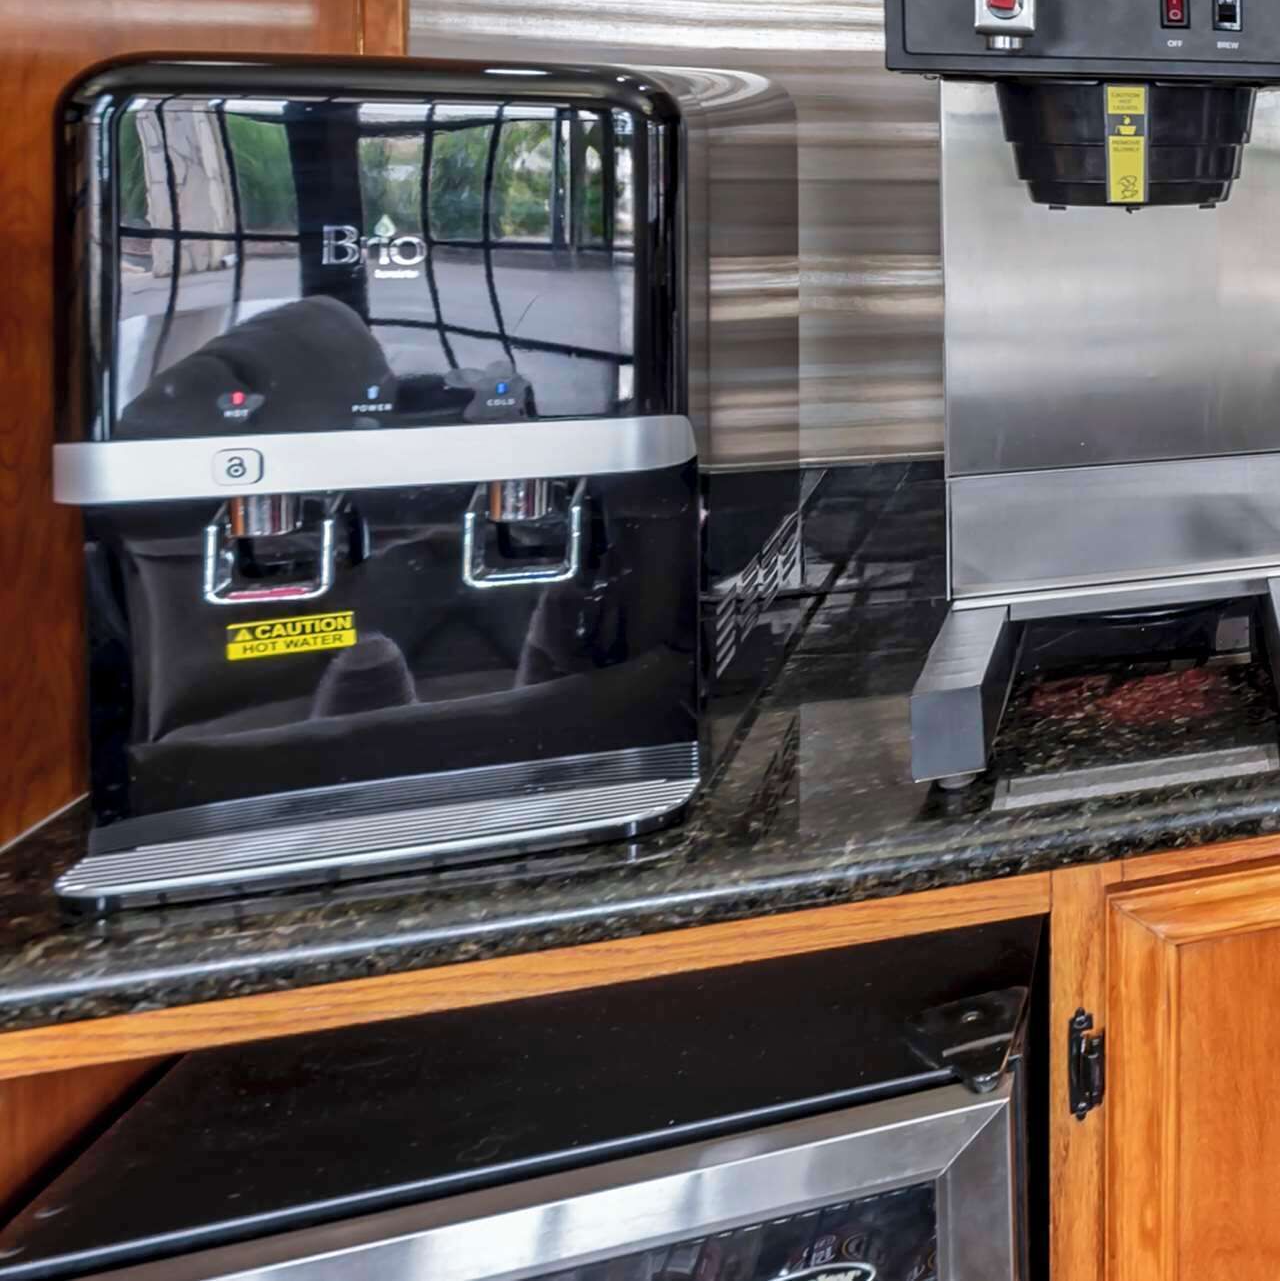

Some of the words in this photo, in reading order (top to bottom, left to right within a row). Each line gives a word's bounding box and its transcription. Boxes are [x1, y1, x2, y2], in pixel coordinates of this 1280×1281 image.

[1167, 39, 1184, 48] OFF
[1217, 40, 1239, 50] BREW
[322, 214, 428, 266] Brio
[352, 402, 393, 413] POWER
[486, 397, 517, 407] COLD
[254, 616, 353, 640] CAUTION
[242, 640, 278, 655] HOT
[284, 633, 344, 650] WATER
